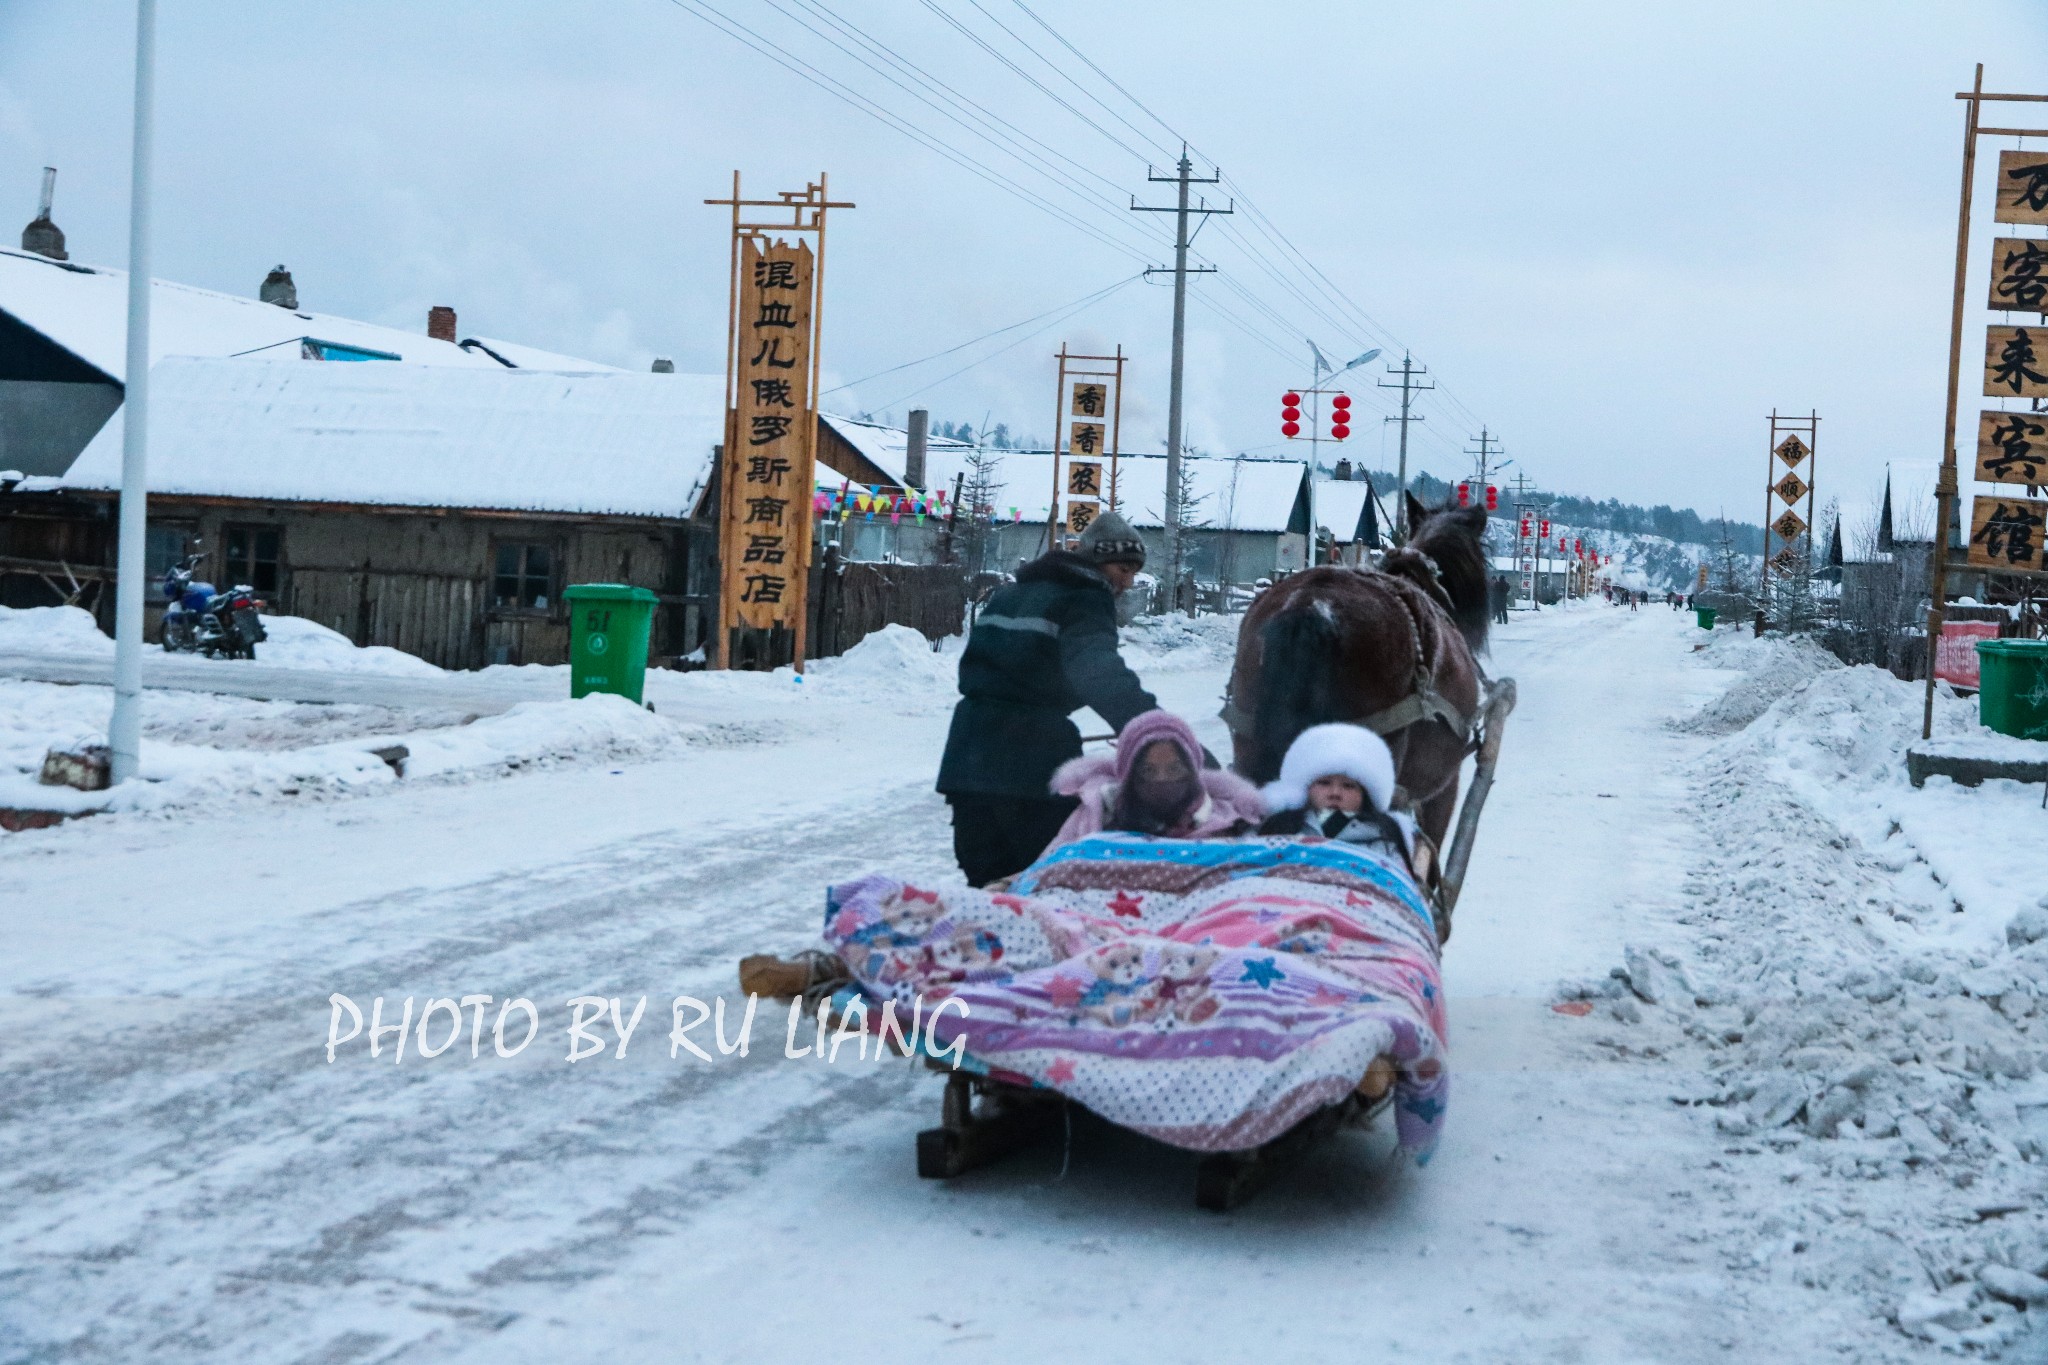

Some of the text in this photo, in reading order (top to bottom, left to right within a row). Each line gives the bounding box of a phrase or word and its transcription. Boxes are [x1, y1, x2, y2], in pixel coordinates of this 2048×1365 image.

[740, 260, 800, 604] 混血儿俄罗斯商品店
[1069, 386, 1101, 552] 香香农家
[1973, 163, 2048, 566] 万客来宾馆
